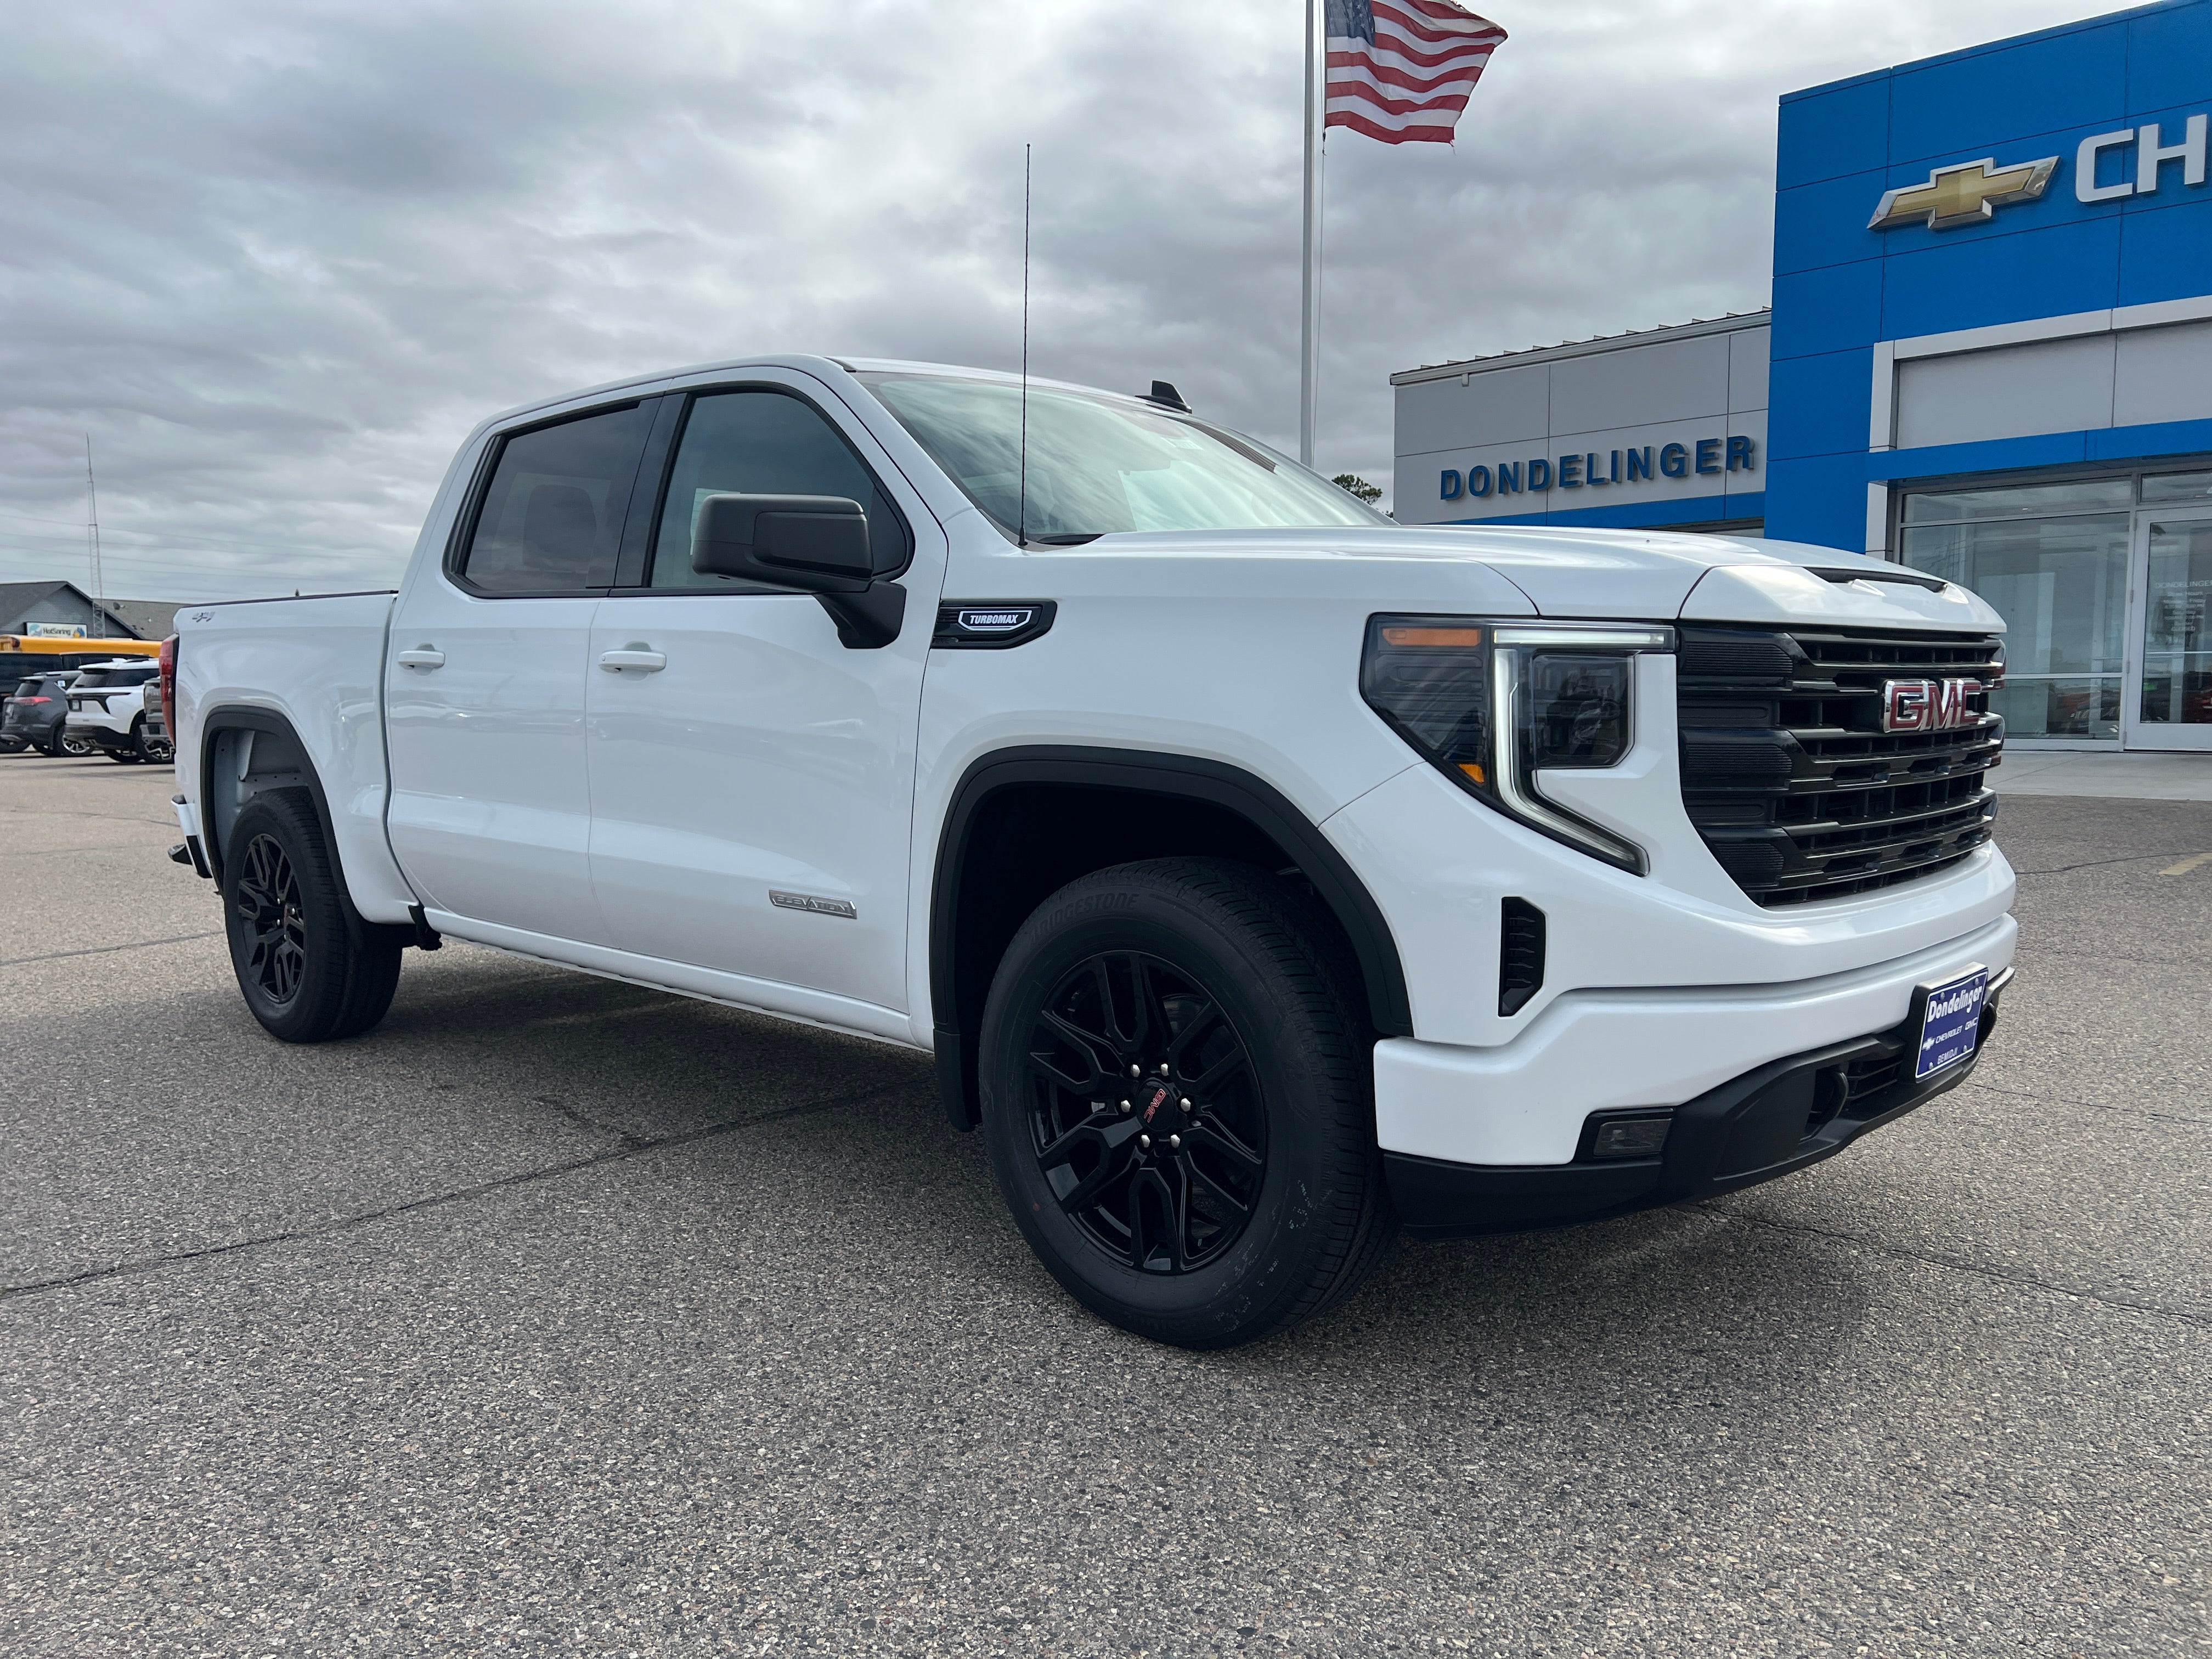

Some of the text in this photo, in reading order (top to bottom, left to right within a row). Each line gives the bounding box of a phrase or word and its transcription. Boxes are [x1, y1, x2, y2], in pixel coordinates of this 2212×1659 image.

[1440, 436, 1755, 500] DONDELINGER
[2155, 580, 2212, 588] DONDELINGE
[970, 614, 1019, 624] TURBOMAX
[1883, 678, 1982, 733] GMC
[776, 894, 848, 912] ELEVATION
[1927, 986, 1982, 1023] Dondelinger
[1936, 1025, 1963, 1044] CHEVROLET
[1143, 1088, 1166, 1124] GMC
